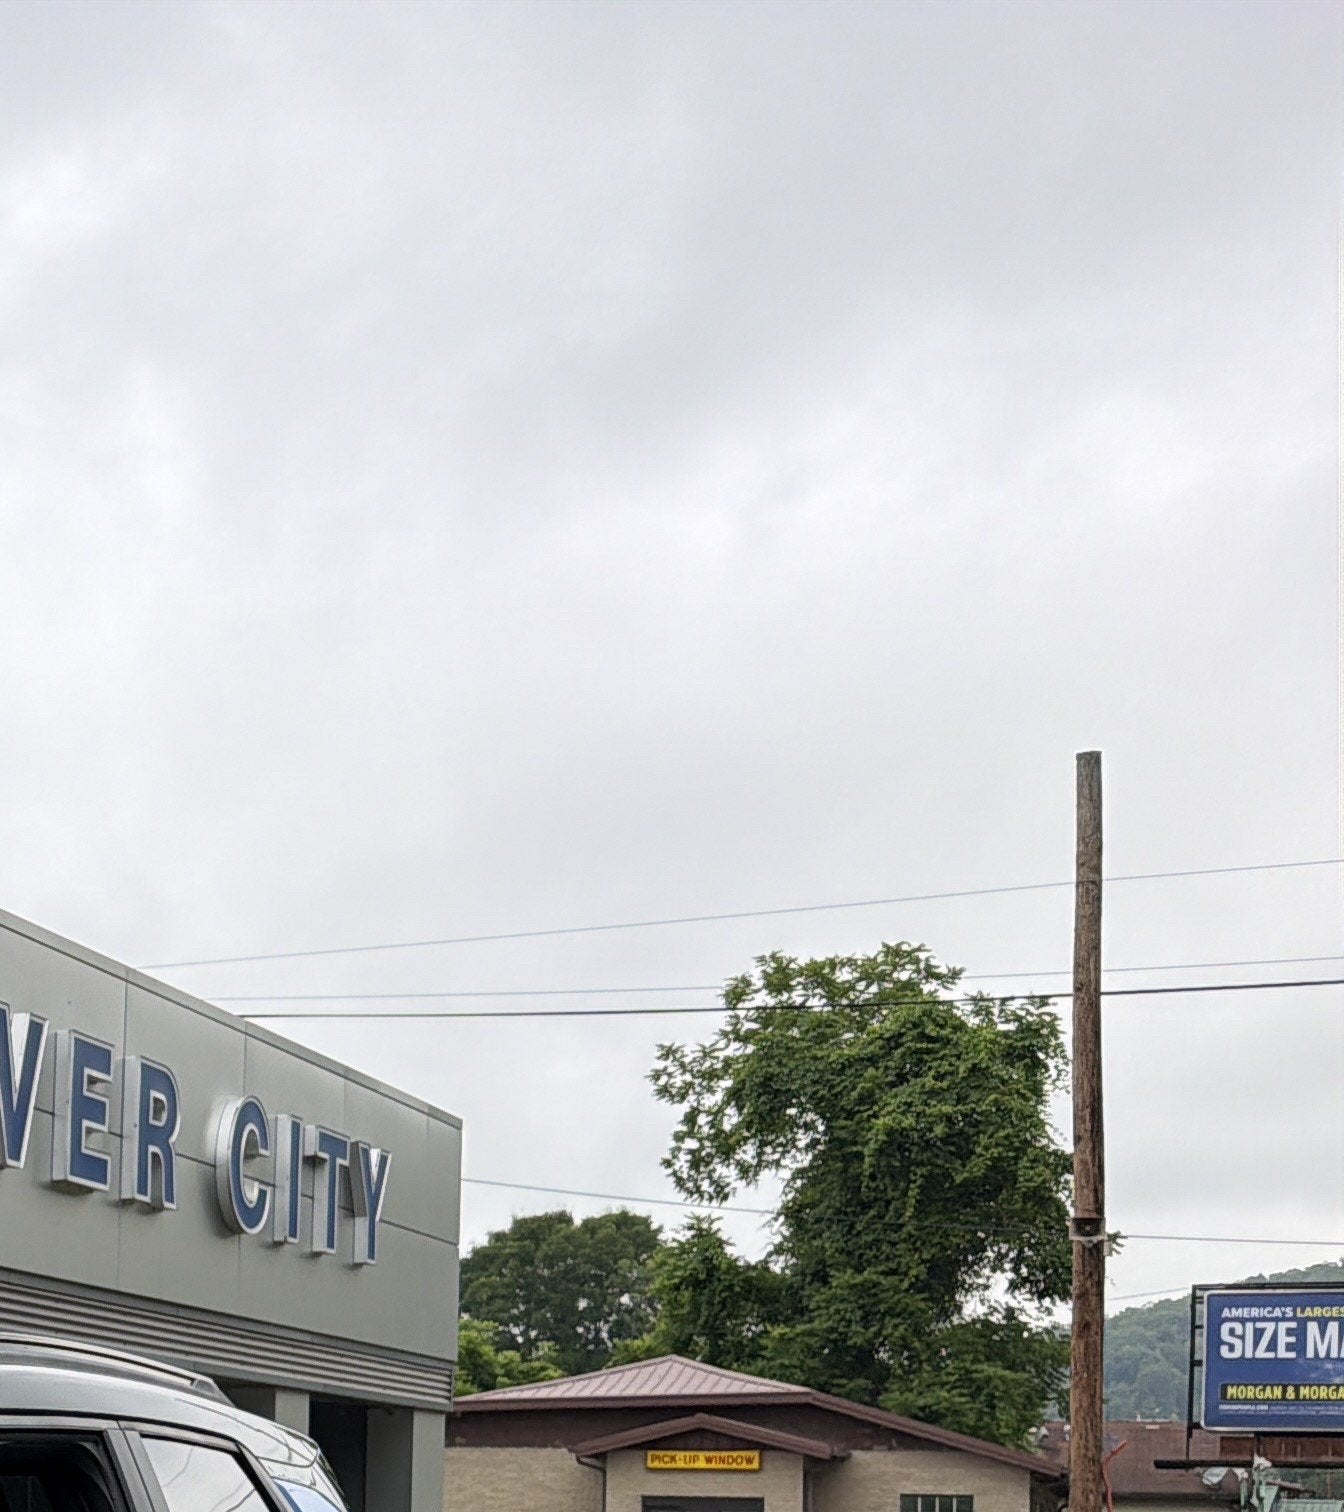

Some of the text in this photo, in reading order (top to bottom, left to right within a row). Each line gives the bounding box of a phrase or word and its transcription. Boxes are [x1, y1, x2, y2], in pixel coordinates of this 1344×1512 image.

[214, 1094, 393, 1265] CITY
[1221, 1306, 1294, 1319] AMERICA'S
[1220, 1320, 1344, 1360] SIZE M
[1226, 1385, 1283, 1400] MORGAN
[1285, 1385, 1296, 1400] &
[650, 1453, 755, 1466] PICK-UP WINDOW
